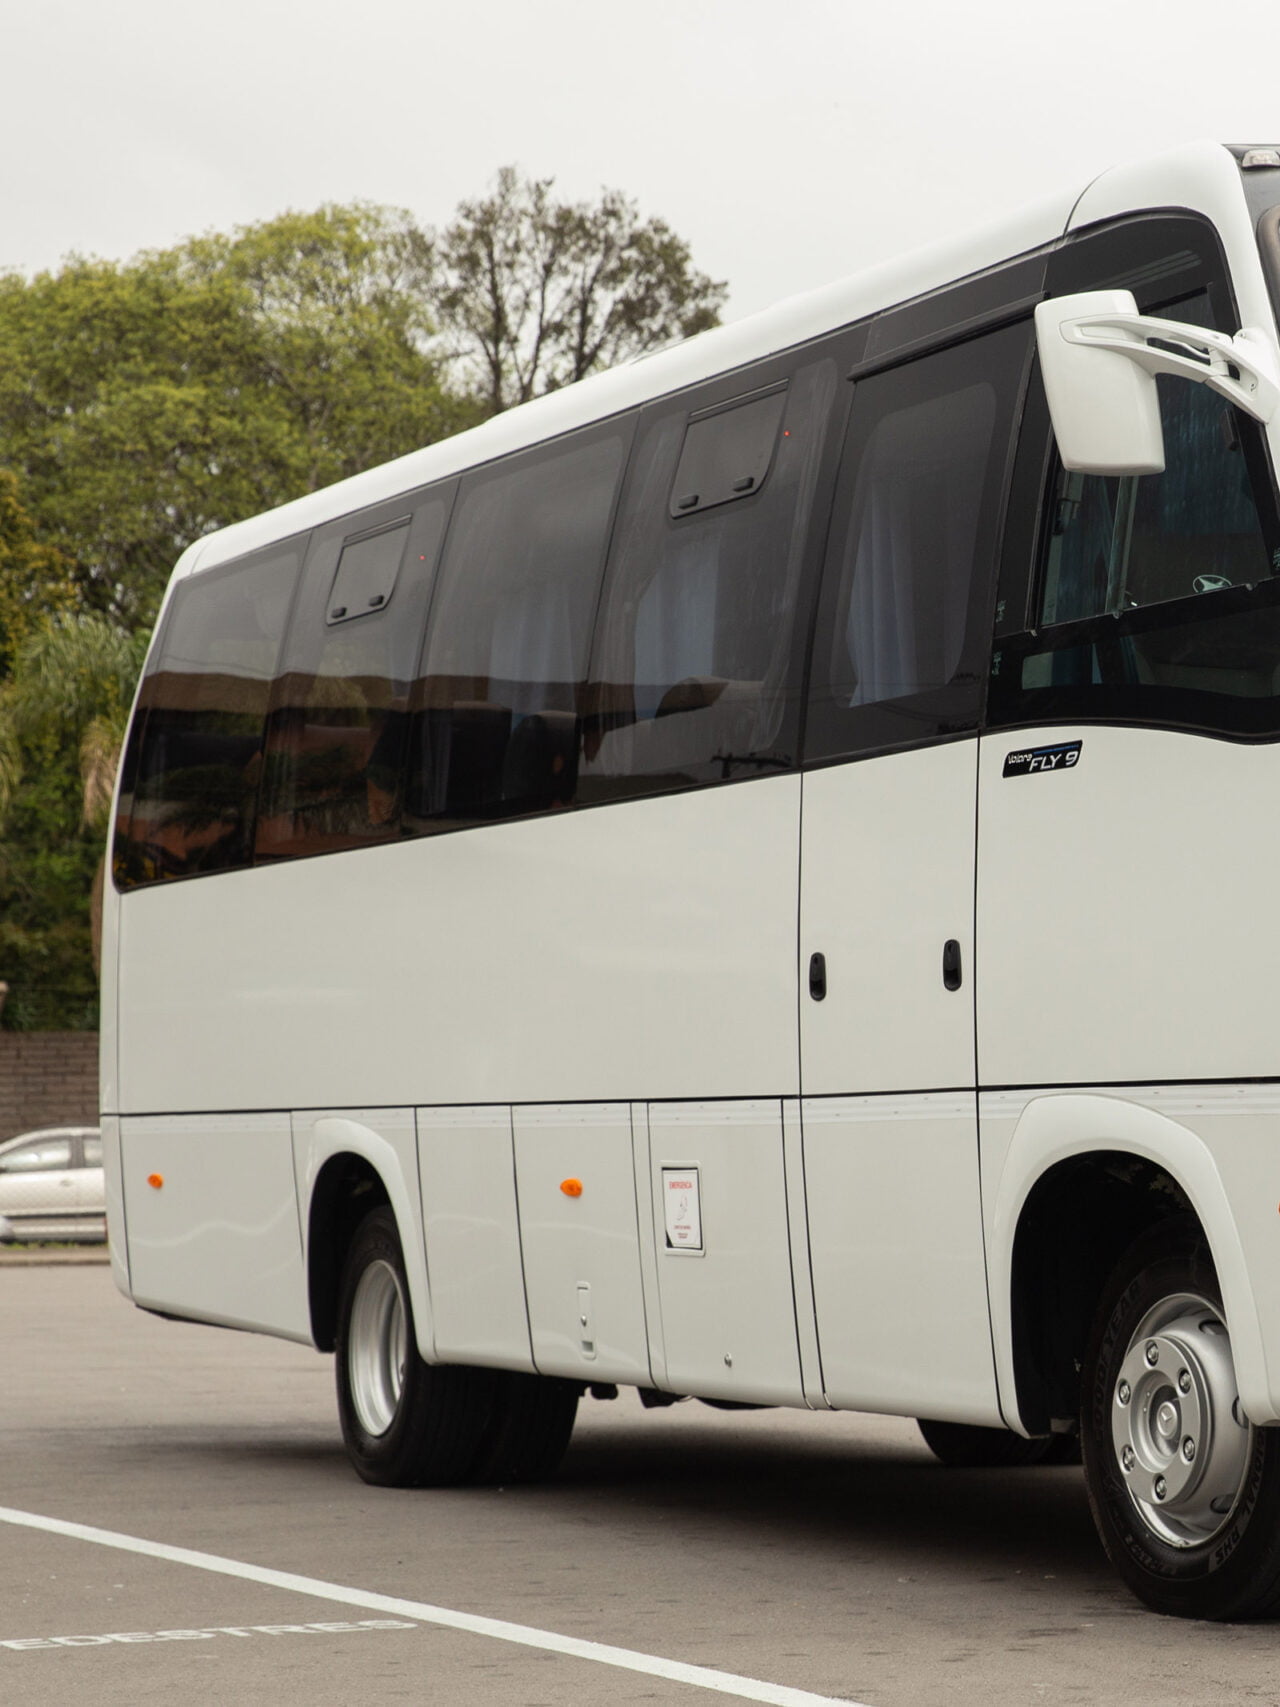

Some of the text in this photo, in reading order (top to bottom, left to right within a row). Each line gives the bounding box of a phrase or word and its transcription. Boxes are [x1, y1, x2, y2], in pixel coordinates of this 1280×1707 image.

[1028, 750, 1079, 772] FLY 9
[0, 1618, 418, 1651] EDESTRES
